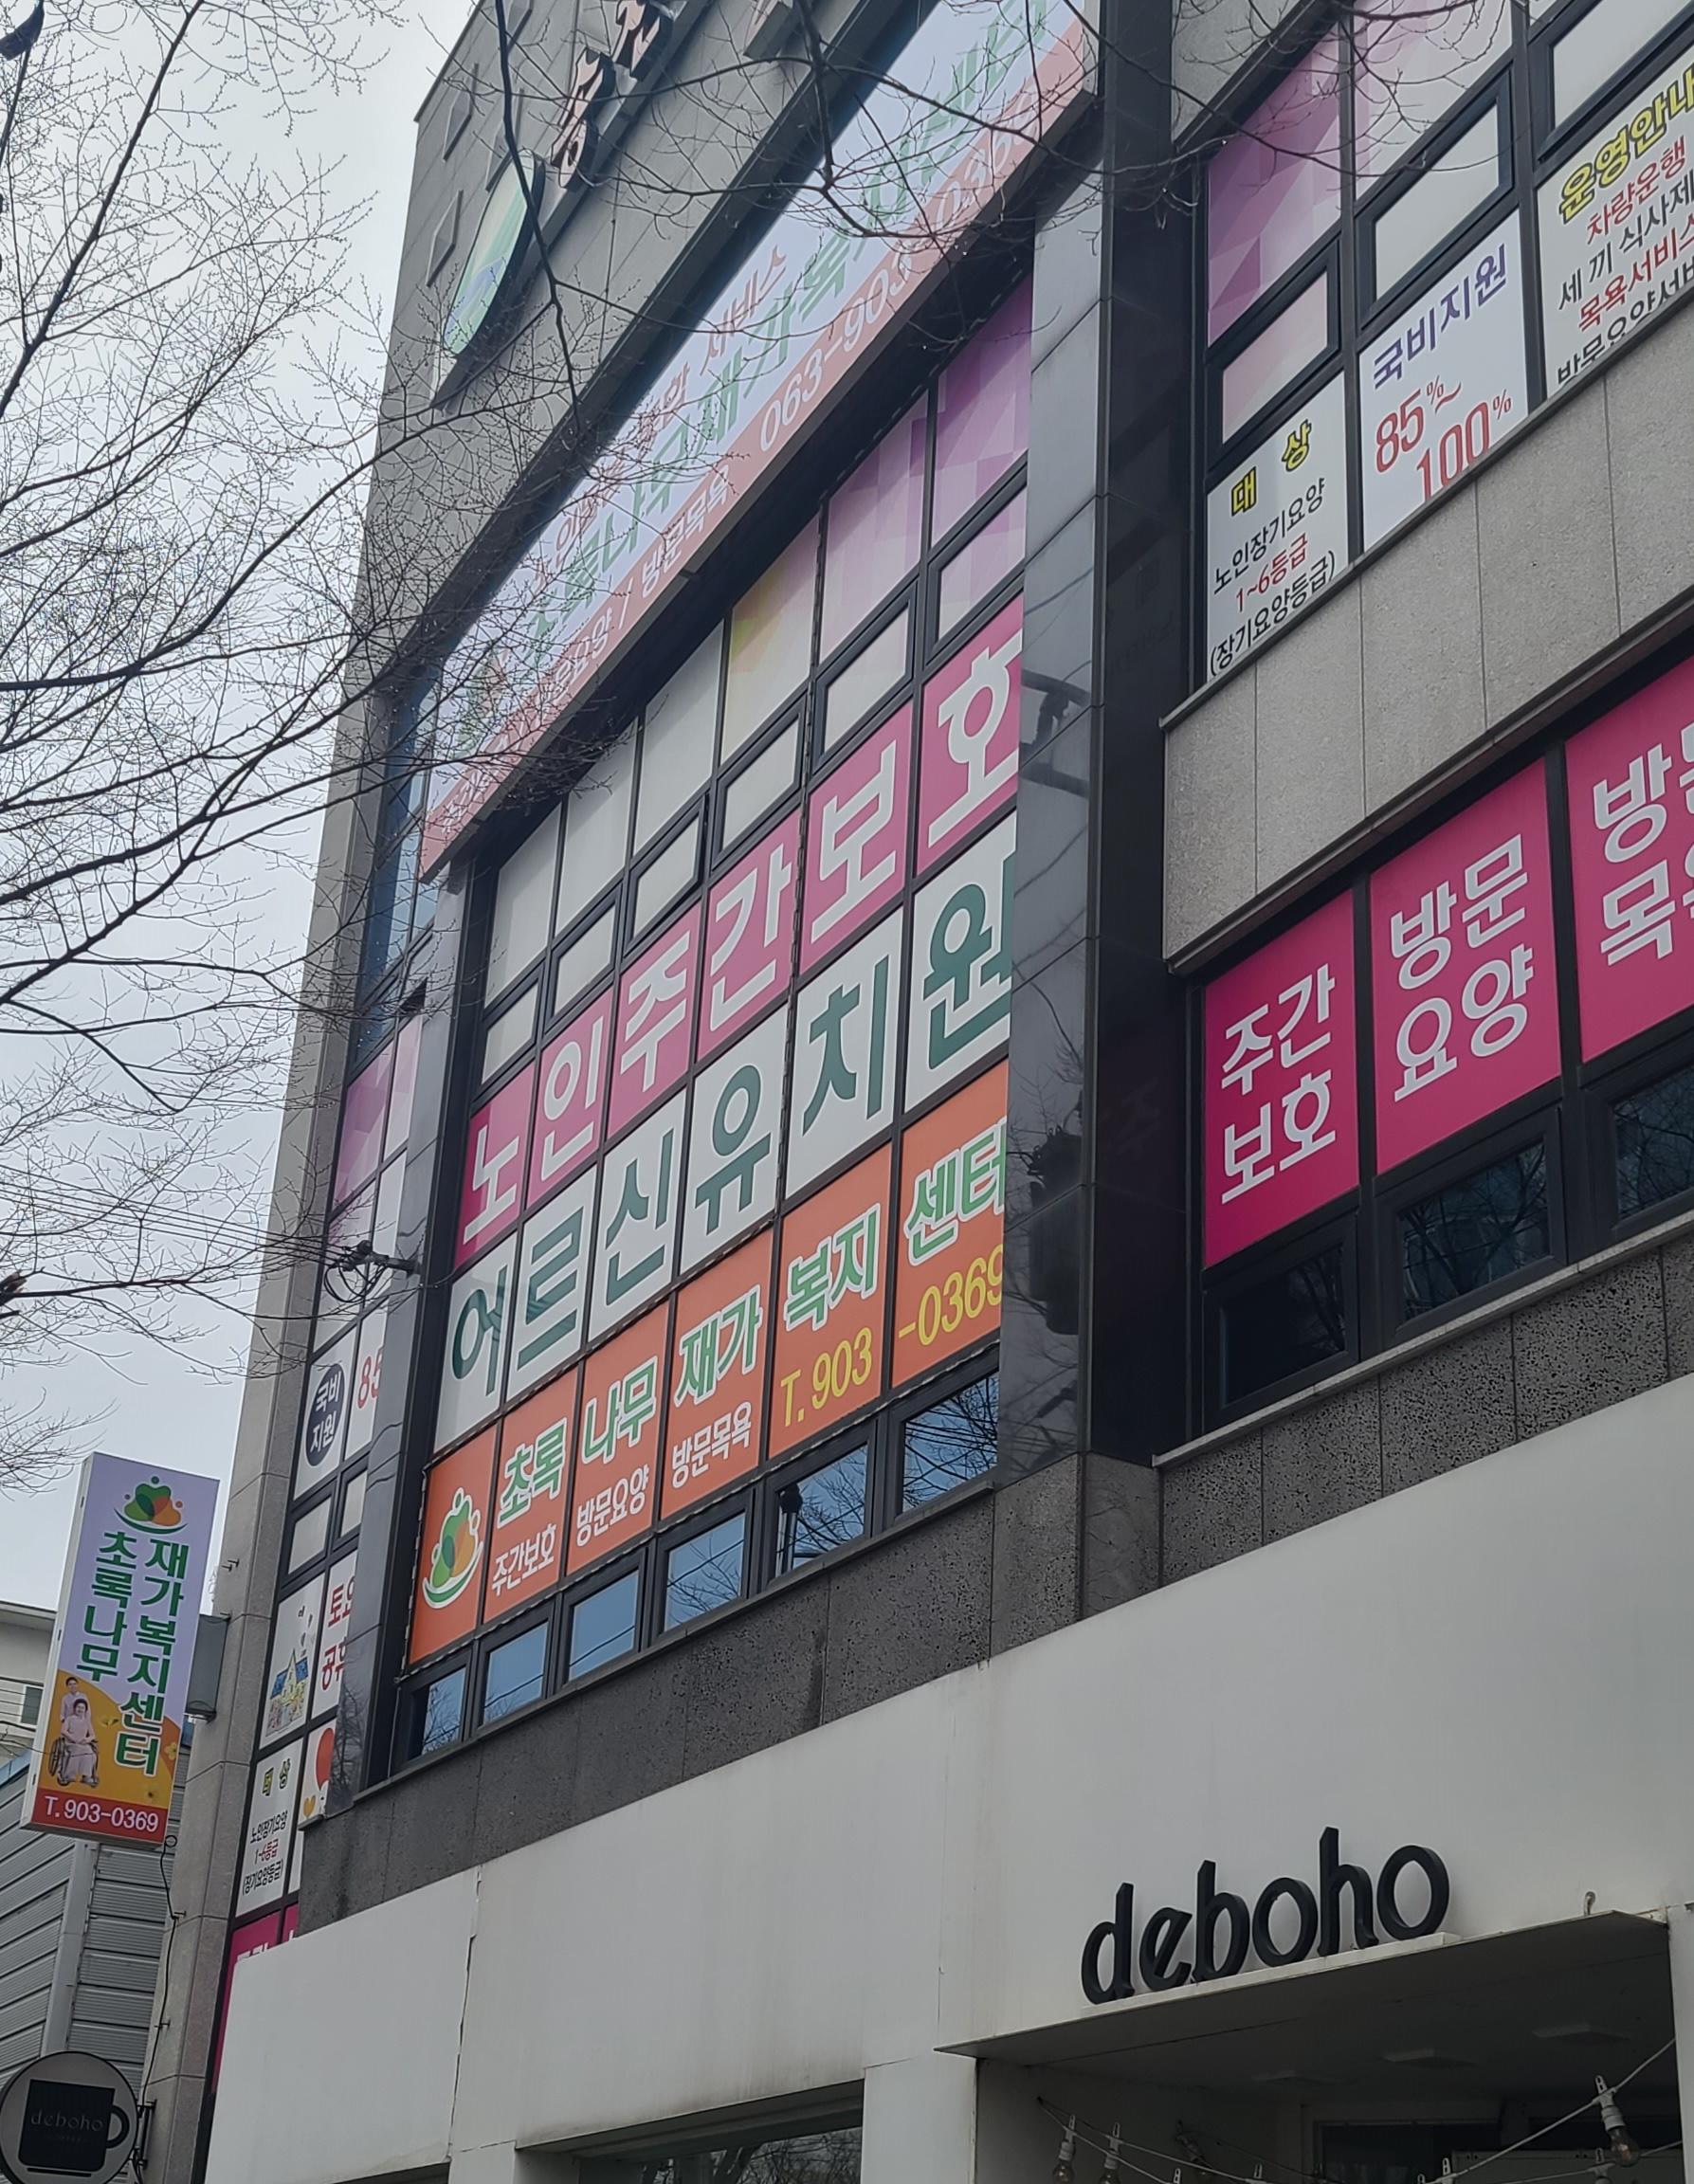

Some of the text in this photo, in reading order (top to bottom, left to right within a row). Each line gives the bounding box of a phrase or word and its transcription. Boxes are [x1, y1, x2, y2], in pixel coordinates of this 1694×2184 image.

[1586, 135, 1685, 245] 차량운행
[701, 246, 787, 376] 서비스
[1374, 243, 1507, 390] 국비지원
[1416, 389, 1512, 500] 100%
[642, 463, 730, 598] 방문목욕
[1213, 478, 1325, 595] 노인장기요양
[1236, 533, 1308, 612] 1~6등급
[1210, 550, 1335, 677] (장기요양등급)
[1593, 722, 1694, 864] 방
[1390, 834, 1528, 990] 방문
[1601, 839, 1694, 967] 목
[1221, 963, 1336, 1095] 주간
[1394, 943, 1535, 1102] 요양
[1221, 1068, 1337, 1204] 보호
[310, 1410, 337, 1452] 지원
[316, 1371, 341, 1411] 국비
[671, 1401, 753, 1489] 방문목욕
[492, 1523, 556, 1596] 주간보호
[576, 1464, 649, 1547] 방문요양
[76, 1530, 137, 1684] 초록나무
[114, 1537, 190, 1777] 재가복지센터
[1081, 1827, 1449, 2005] deboho
[30, 2109, 104, 2132] deboho
